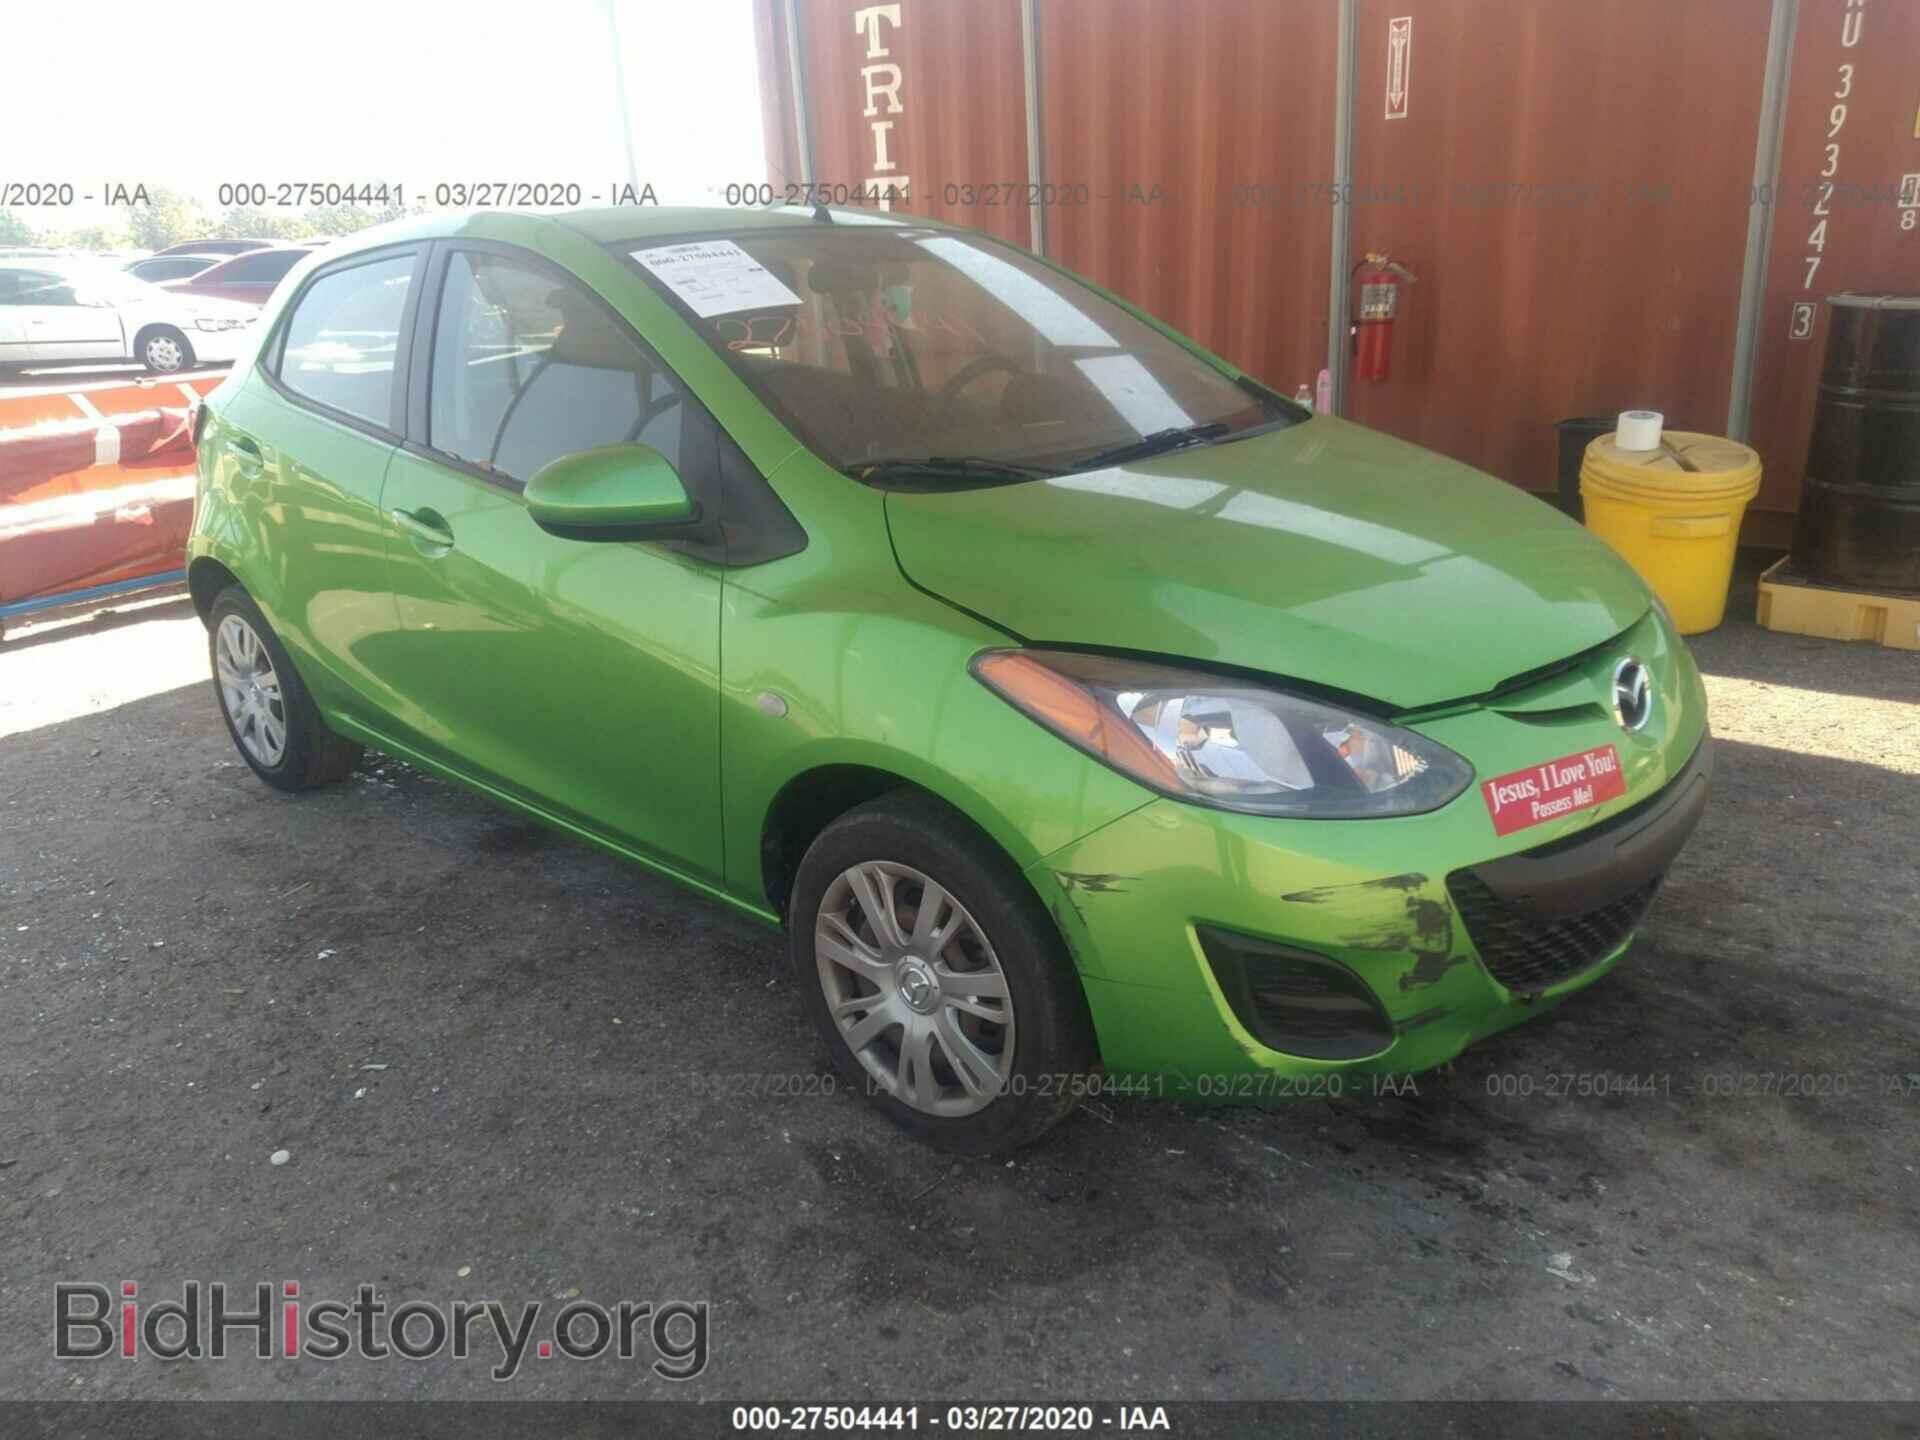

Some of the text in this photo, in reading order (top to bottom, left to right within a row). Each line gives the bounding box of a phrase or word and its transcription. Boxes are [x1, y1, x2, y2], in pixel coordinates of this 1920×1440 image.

[1841, 0, 1863, 47] U
[1793, 305, 1812, 337] 3
[1488, 748, 1617, 814] Jesus, I Love You!
[1531, 785, 1594, 820] Possess Me!
